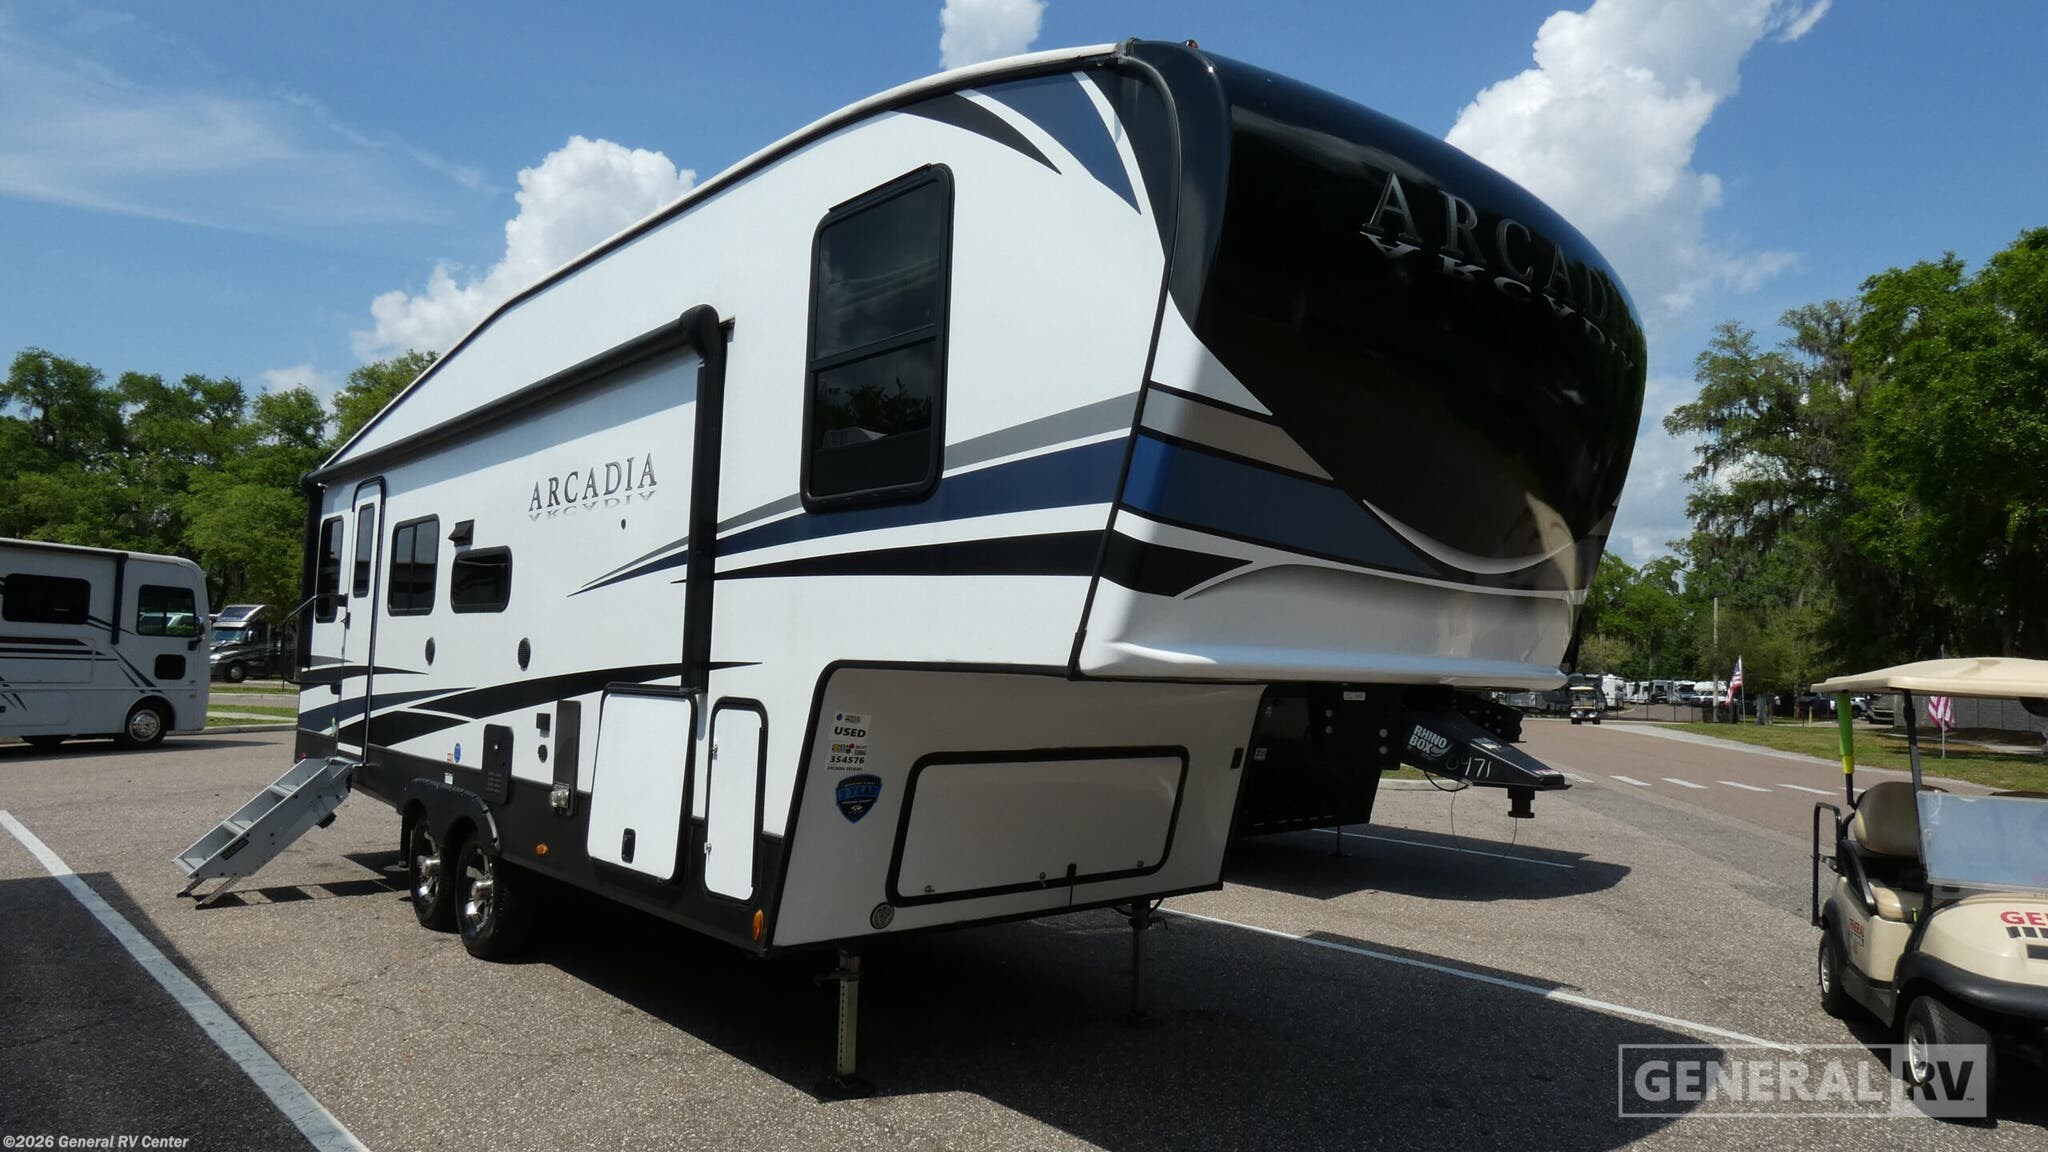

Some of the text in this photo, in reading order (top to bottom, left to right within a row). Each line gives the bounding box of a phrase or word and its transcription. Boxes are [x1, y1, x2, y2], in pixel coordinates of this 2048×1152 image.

[528, 452, 657, 512] ARCADIA
[834, 726, 866, 738] USED
[1413, 724, 1448, 749] RHINO
[1408, 734, 1434, 754] BOX
[829, 755, 865, 764] 354576
[2000, 911, 2048, 926] GE
